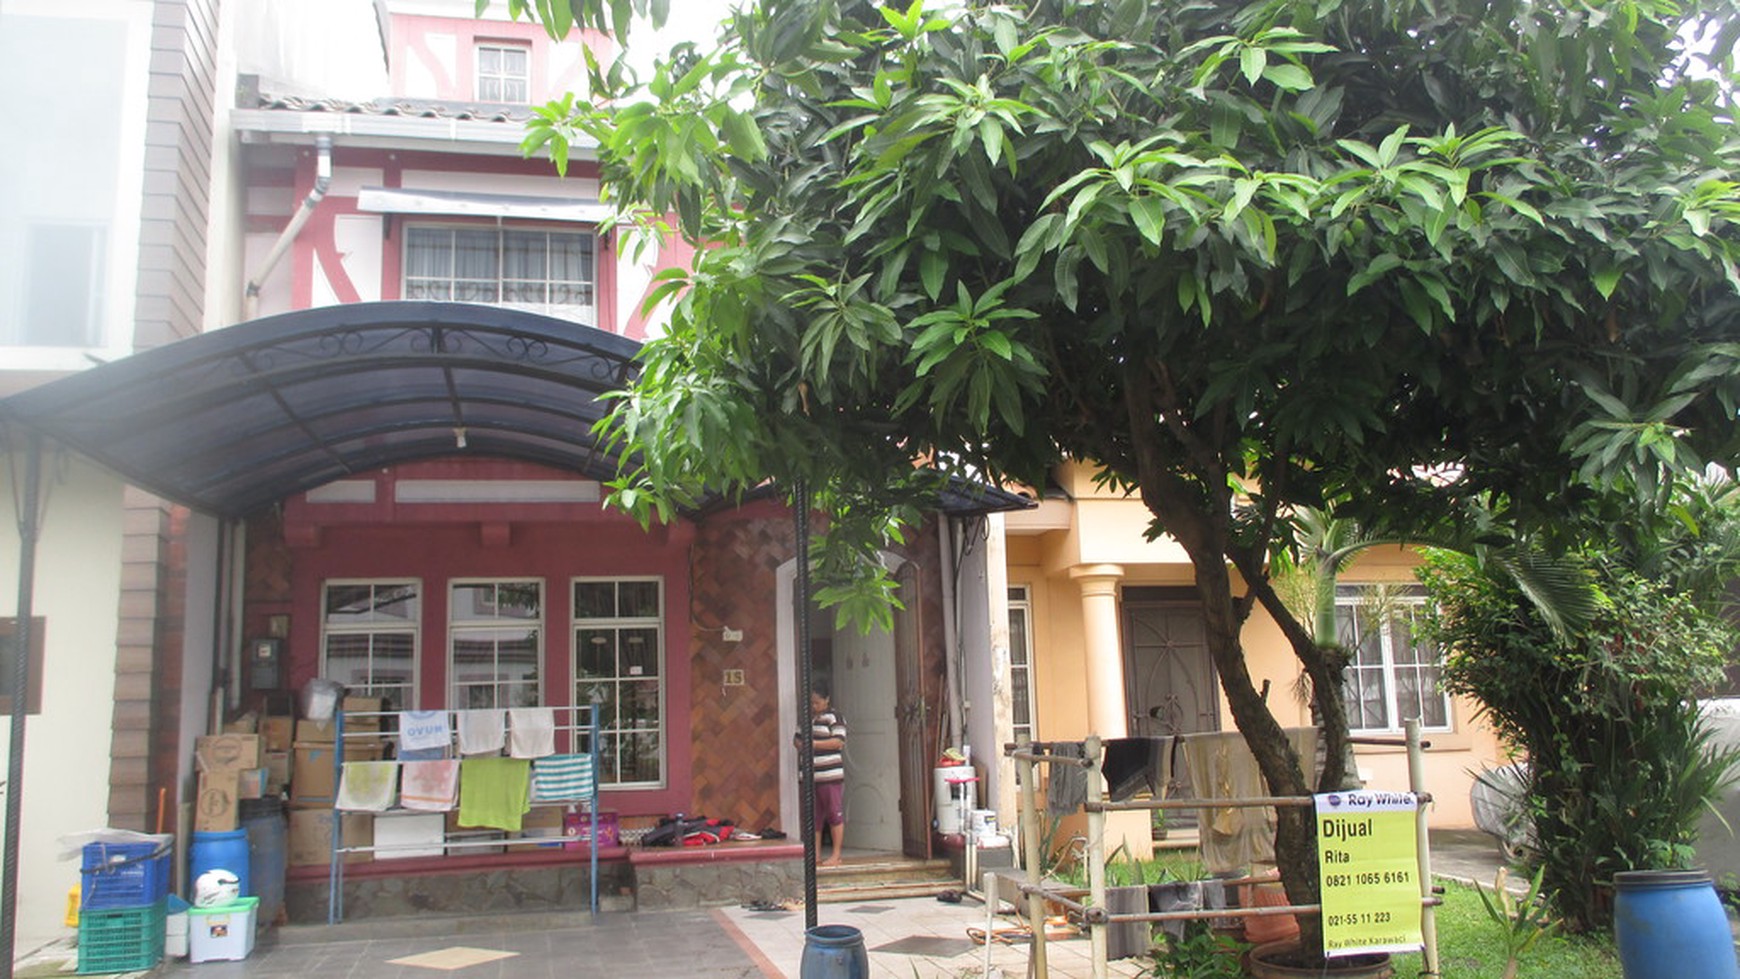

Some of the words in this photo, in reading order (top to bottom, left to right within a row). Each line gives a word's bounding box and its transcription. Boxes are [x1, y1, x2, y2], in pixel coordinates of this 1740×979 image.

[726, 671, 742, 684] 15
[1348, 793, 1373, 807] Ray
[1375, 793, 1412, 805] White
[1323, 818, 1372, 841] Dijual
[1325, 850, 1350, 864] Rita
[1326, 875, 1351, 887] 0821
[1356, 872, 1380, 885] 1065
[1384, 871, 1409, 884] 6161
[1328, 913, 1358, 926] 021-55
[1361, 913, 1371, 924] 11
[1375, 911, 1391, 923] 223
[1328, 939, 1342, 948] Ray
[1344, 937, 1367, 947] White
[1369, 934, 1406, 944] Karawaci
